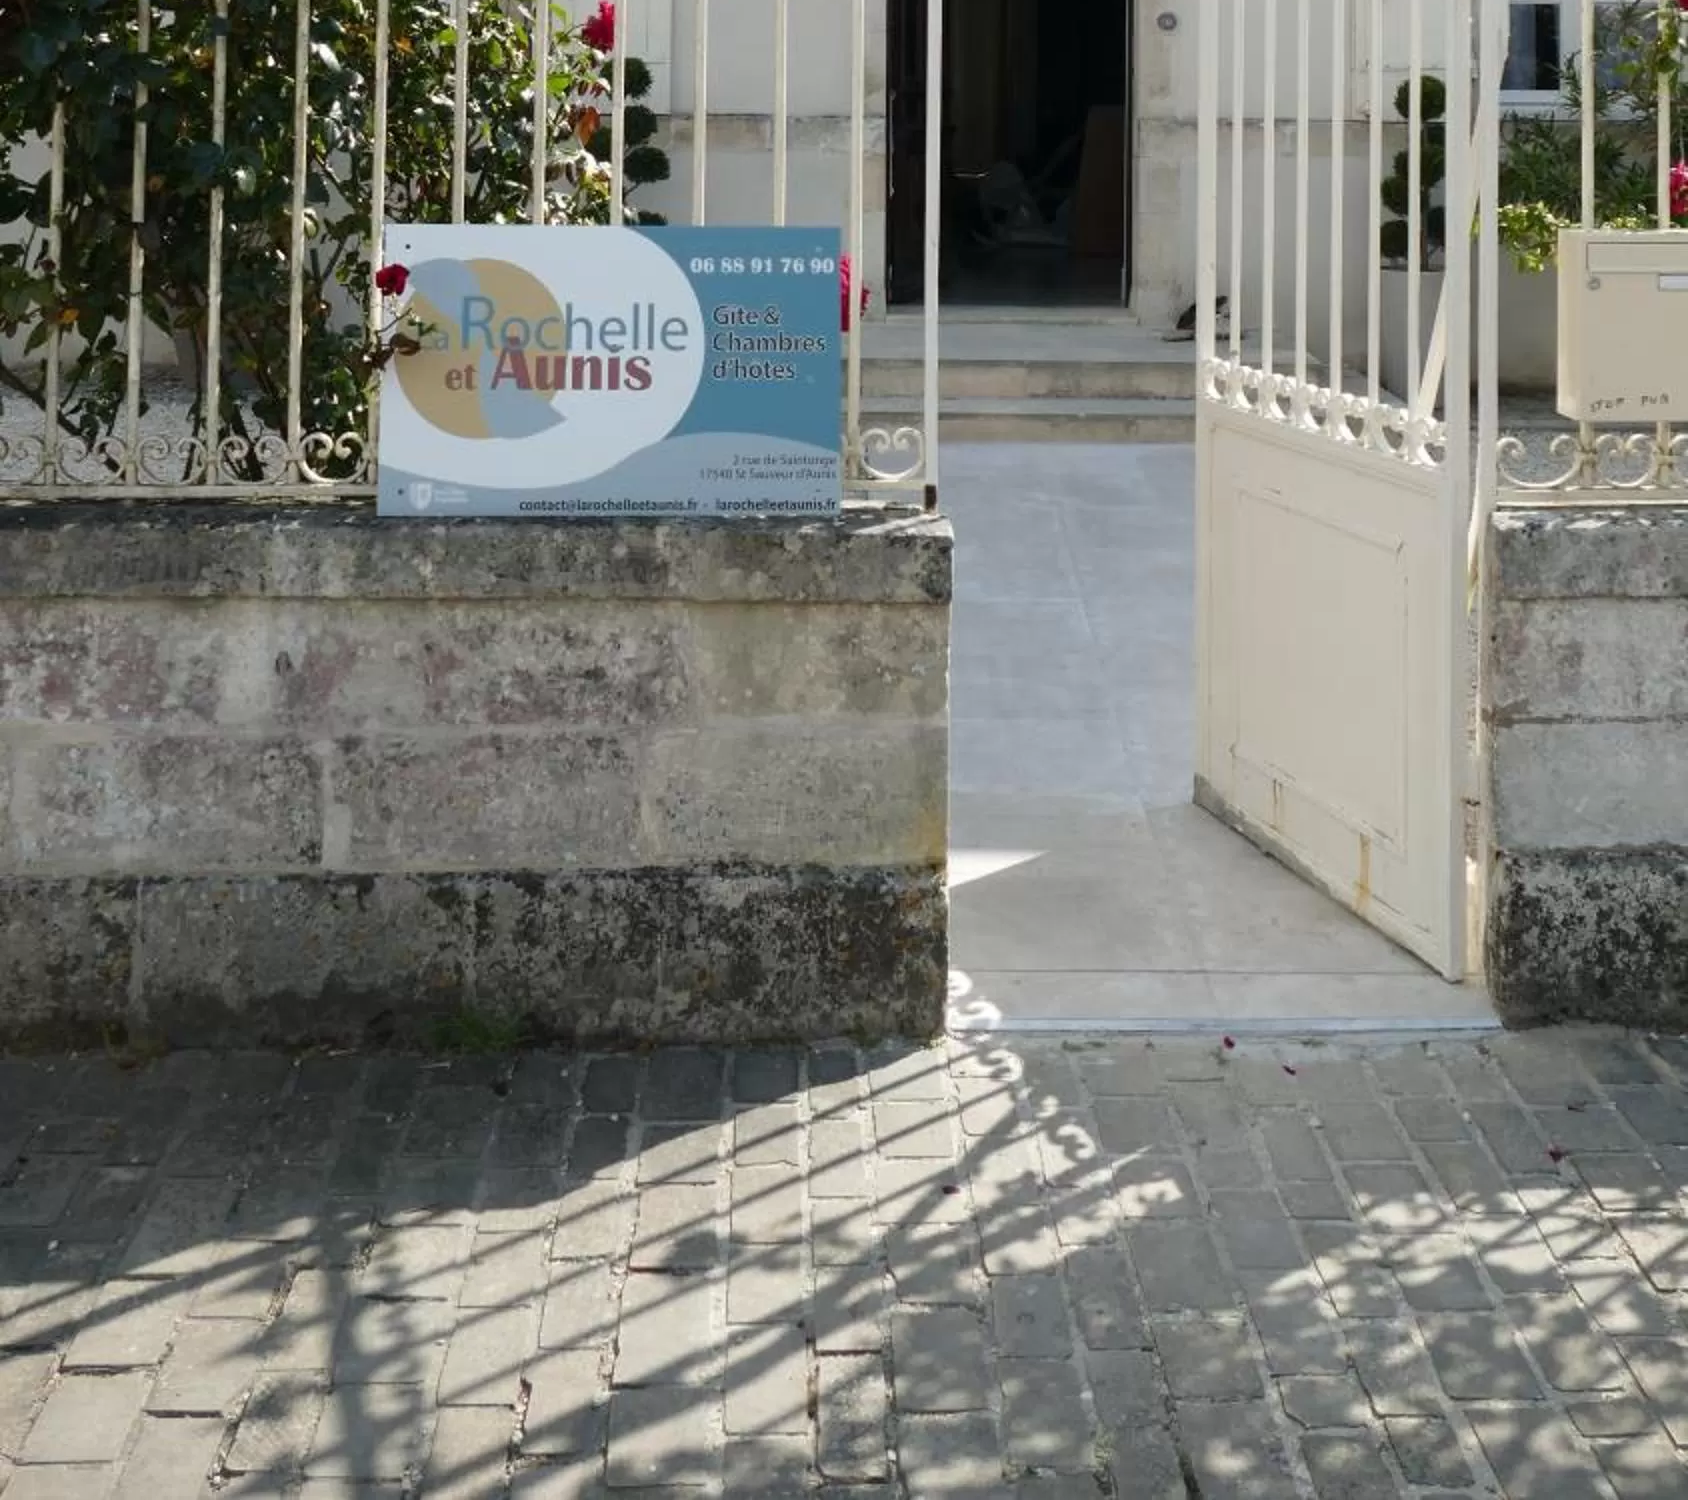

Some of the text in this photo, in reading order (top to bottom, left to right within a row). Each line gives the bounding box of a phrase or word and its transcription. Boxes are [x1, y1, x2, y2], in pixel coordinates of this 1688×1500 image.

[690, 257, 835, 274] 06 88 91 76 90
[461, 296, 688, 351] Rochelle
[763, 304, 780, 325] &
[713, 331, 825, 351] Chambres
[445, 336, 653, 391] et Aunis
[715, 498, 837, 511] larochelleetaunis.fr
